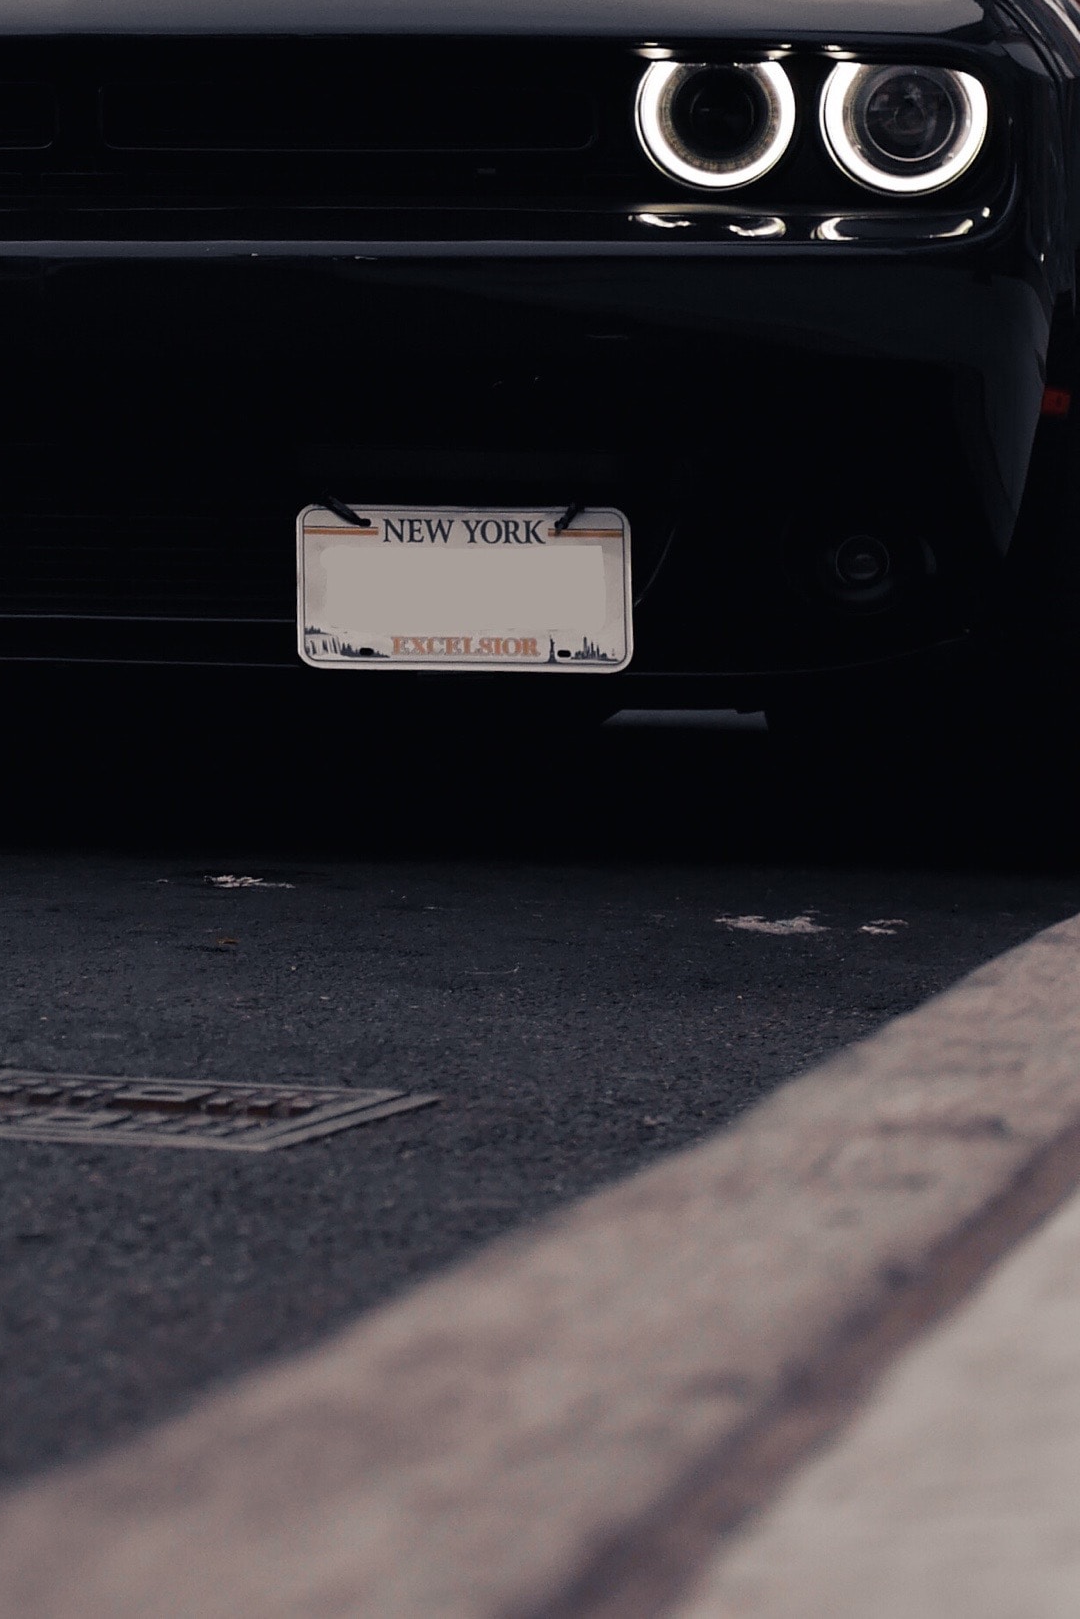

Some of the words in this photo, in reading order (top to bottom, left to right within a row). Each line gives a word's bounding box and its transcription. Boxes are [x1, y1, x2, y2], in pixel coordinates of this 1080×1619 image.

[382, 518, 455, 544] NEW
[461, 519, 547, 545] YORK
[390, 635, 542, 658] EXCELSIOR
